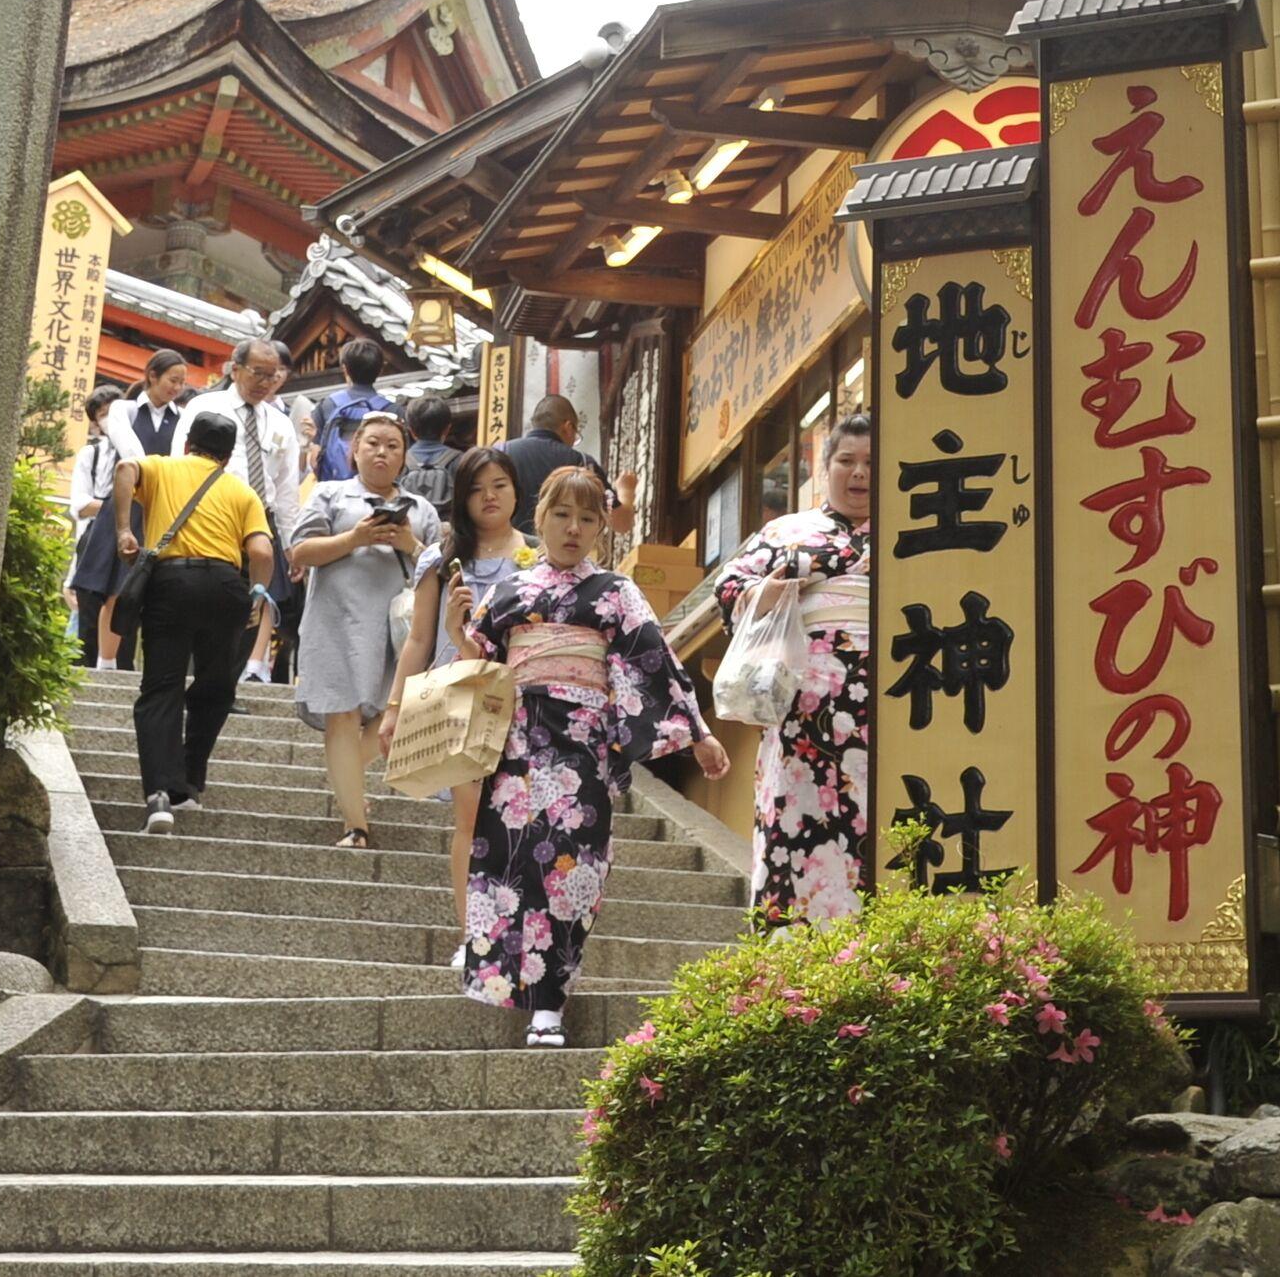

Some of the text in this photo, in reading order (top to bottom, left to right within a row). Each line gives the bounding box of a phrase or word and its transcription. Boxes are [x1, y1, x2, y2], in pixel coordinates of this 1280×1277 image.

[730, 272, 765, 324] CHARMS
[797, 199, 820, 251] JISHU
[1010, 329, 1031, 359] じ
[884, 281, 1019, 895] 地主神社
[1072, 85, 1223, 922] えんむすびの神
